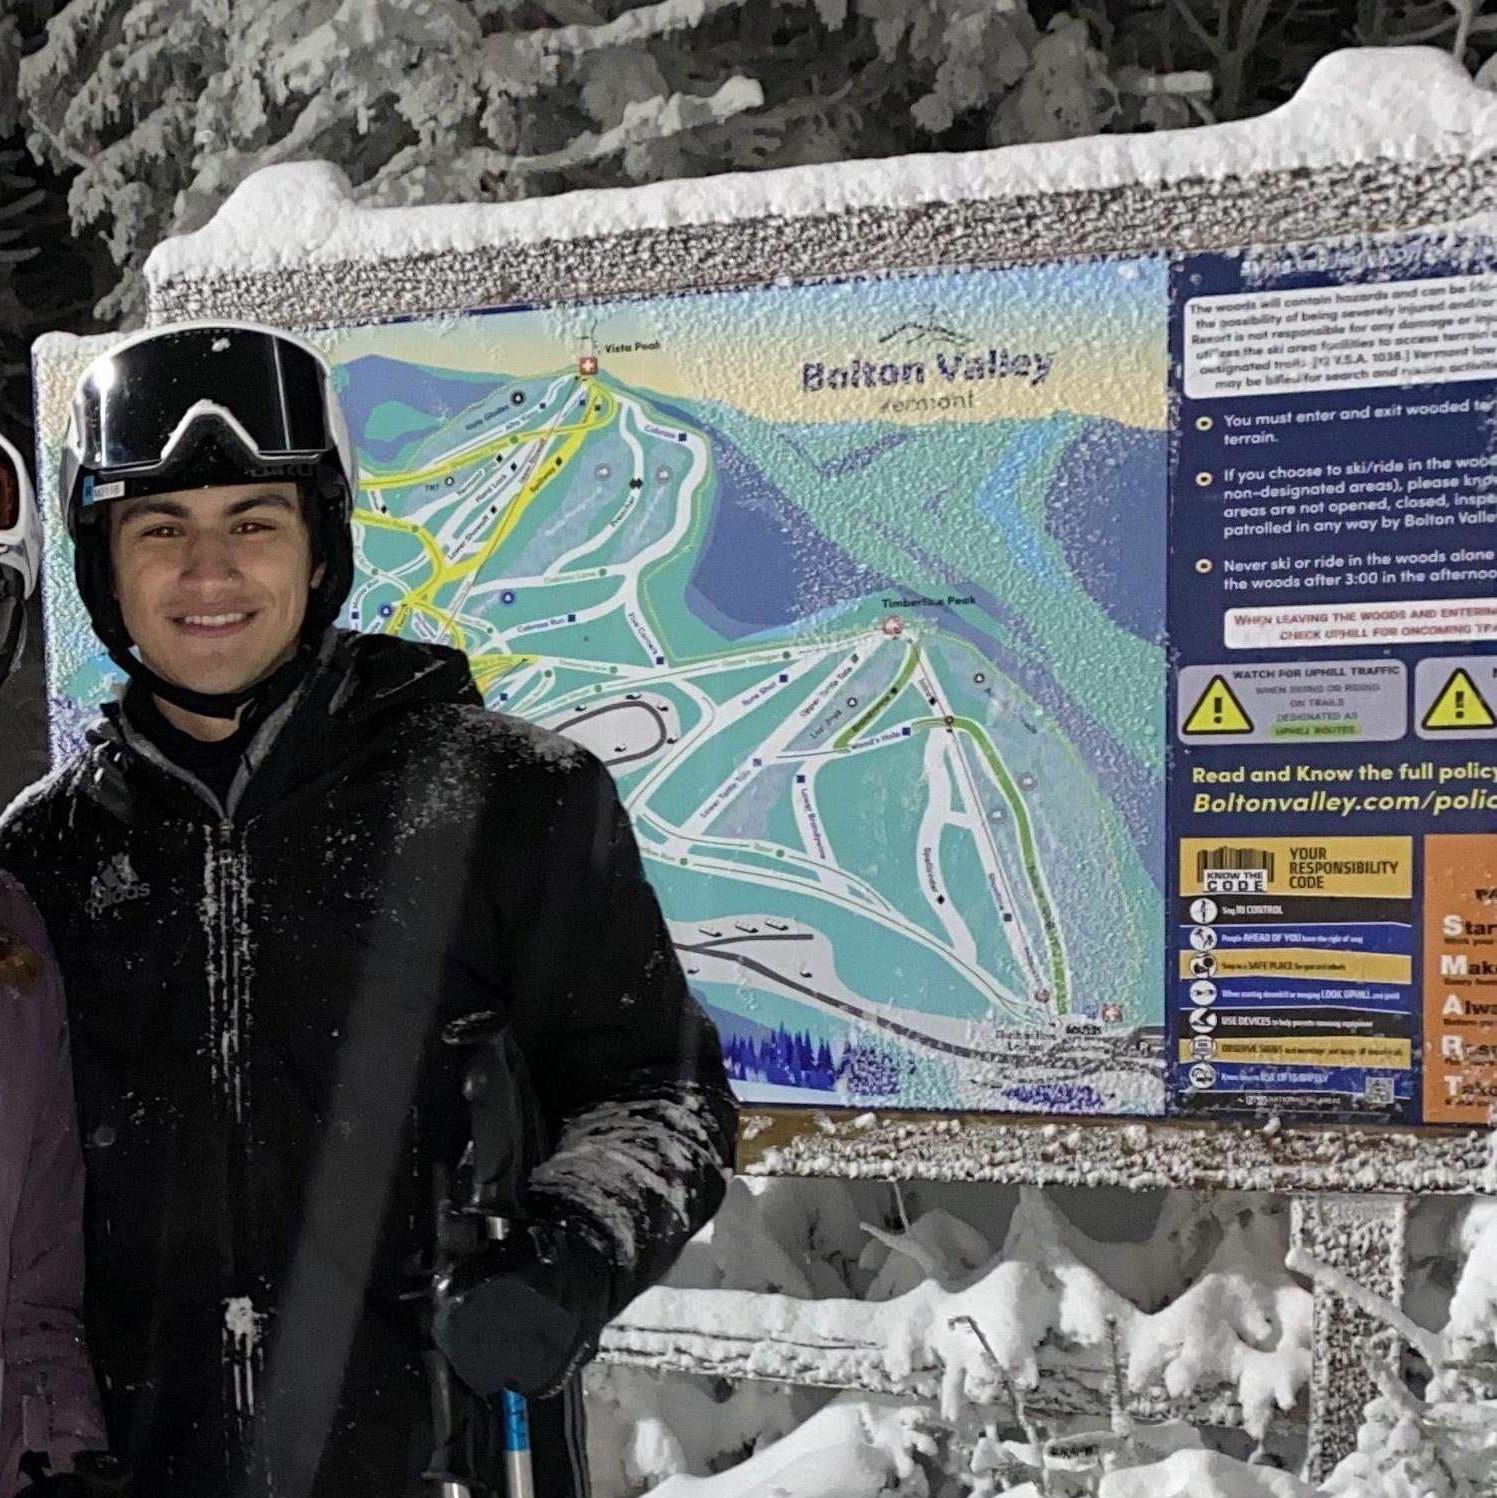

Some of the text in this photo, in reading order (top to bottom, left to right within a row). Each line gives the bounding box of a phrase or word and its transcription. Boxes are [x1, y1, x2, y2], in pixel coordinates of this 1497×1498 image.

[1392, 288, 1418, 299] and
[1421, 288, 1446, 298] can
[1449, 285, 1466, 294] be
[1248, 331, 1269, 341] not
[1272, 325, 1346, 341] responsible
[1370, 322, 1395, 334] any
[605, 344, 632, 354] Vista
[1243, 347, 1264, 357] the
[802, 347, 1056, 392] Bolton Valley
[1246, 377, 1262, 387] be
[1372, 367, 1398, 377] and
[1224, 399, 1471, 428] You must enter and exit wooded
[1224, 430, 1279, 446] terrain.
[1224, 457, 1452, 485] If you choose to ski/ride in the
[1223, 480, 1346, 500] non-designated
[1348, 478, 1403, 493] areas),
[1407, 476, 1460, 493] please
[1223, 494, 1450, 518] areas are not opened, closed,
[1224, 520, 1293, 540] patrolled
[1296, 520, 1310, 533] in
[1313, 521, 1342, 535] any
[1345, 518, 1379, 532] way
[1381, 515, 1401, 531] by
[1404, 513, 1455, 527] Bolton
[1224, 548, 1495, 573] Never ski or ride in the woods alone
[1224, 577, 1248, 591] the
[1251, 575, 1301, 589] woods
[1304, 573, 1342, 587] after
[1345, 571, 1378, 586] 3:00
[1381, 570, 1397, 584] in
[1400, 569, 1426, 583] the
[947, 595, 976, 605] Peak
[1234, 608, 1438, 626] WHEN LEAVING THE WOODS AND
[1279, 624, 1472, 641] CHECK UPHILL FOR ONCOMING
[1233, 665, 1400, 680] WATCH FOR UPHILL TRAFFIC
[1309, 697, 1346, 708] TRAILS
[1276, 712, 1341, 723] DESIGNATED
[1192, 766, 1245, 783] Read
[1250, 765, 1291, 782] and
[1297, 765, 1354, 782] Know
[1359, 763, 1394, 781] the
[1398, 762, 1433, 780] full
[1289, 847, 1327, 860] YOUR
[1206, 871, 1264, 880] KNOW THE
[1289, 861, 1399, 875] RESPONSIBILITY
[1207, 880, 1264, 891] CODE
[1289, 875, 1324, 889] CODE
